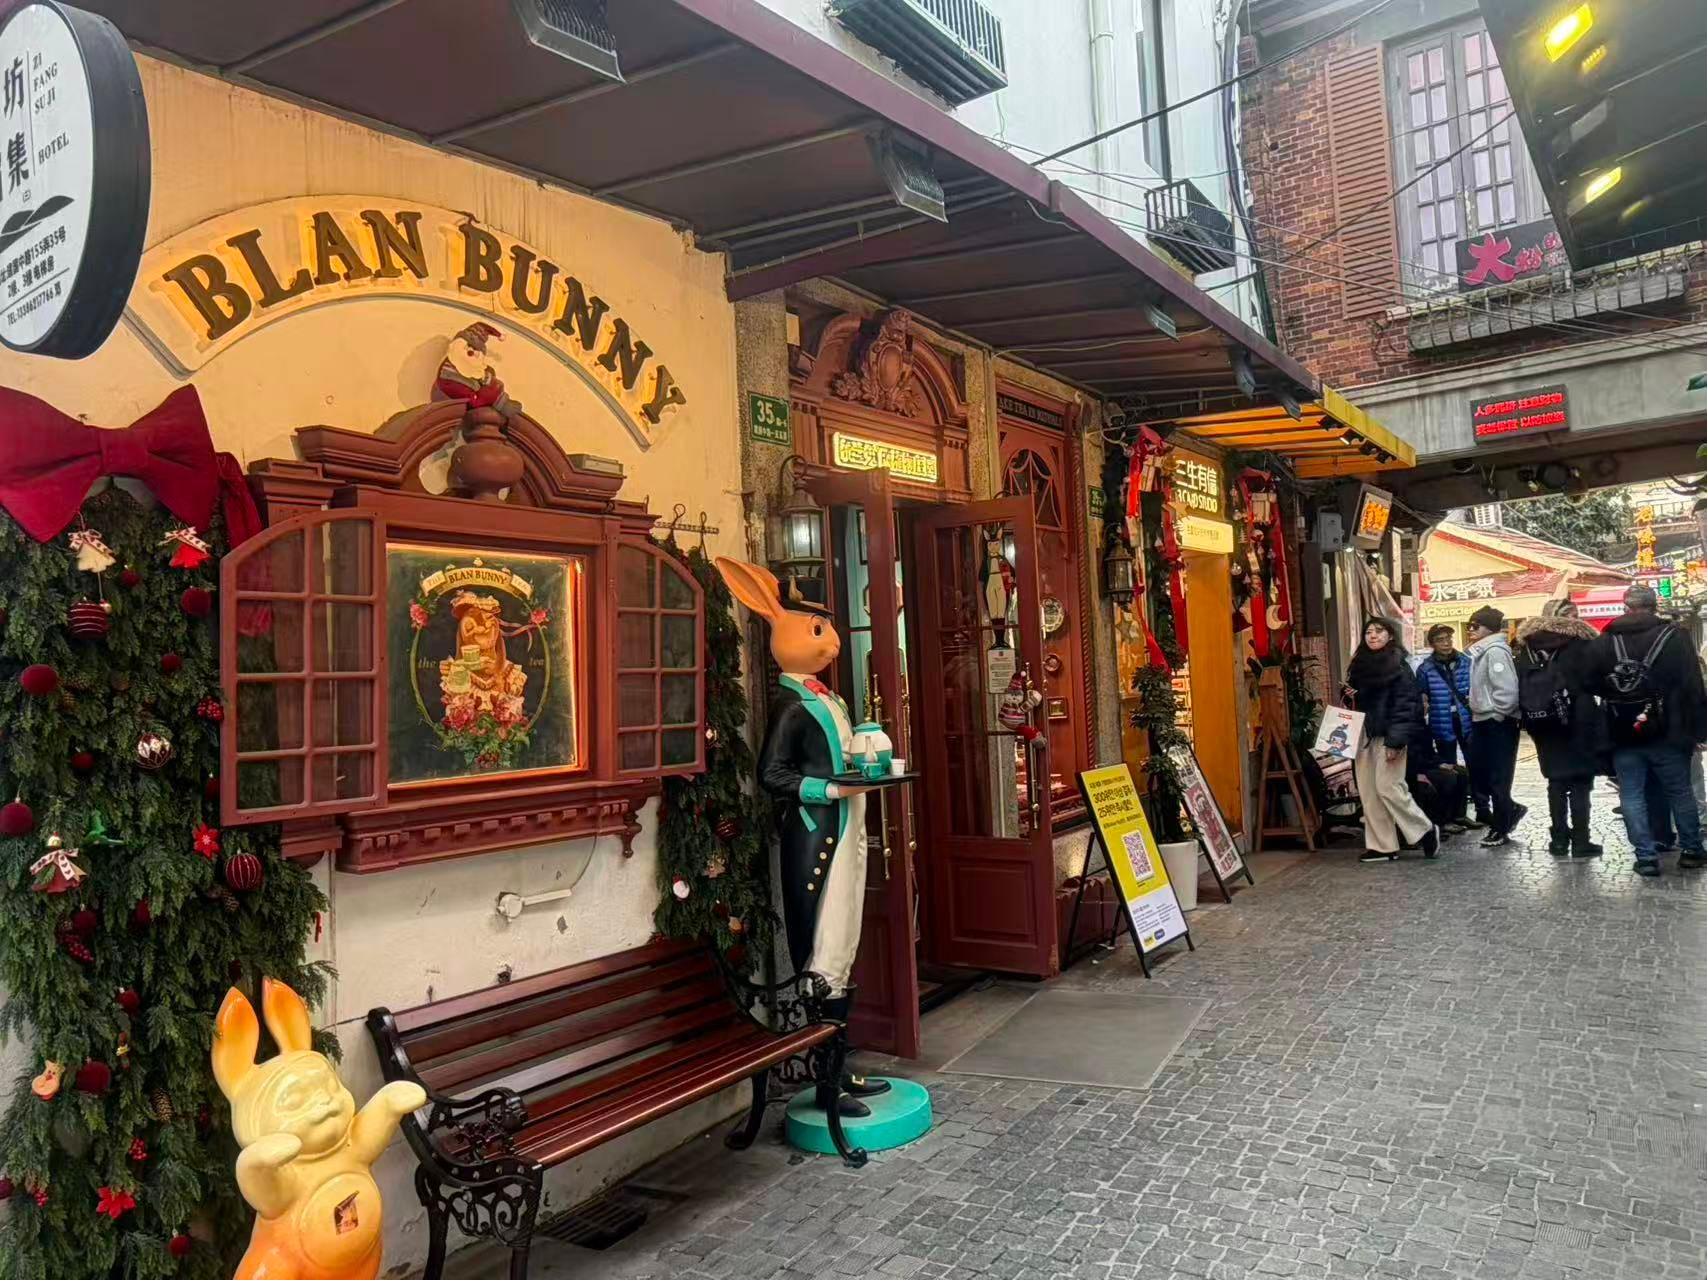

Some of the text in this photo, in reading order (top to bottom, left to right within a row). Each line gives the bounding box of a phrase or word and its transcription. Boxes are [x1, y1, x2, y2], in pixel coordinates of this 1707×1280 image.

[33, 52, 43, 71] ZI
[33, 62, 58, 92] FANG
[38, 132, 70, 165] HOTEL
[164, 209, 686, 425] BLAN BUNNY
[448, 569, 473, 584] BLAN
[474, 569, 508, 585] BUNNY
